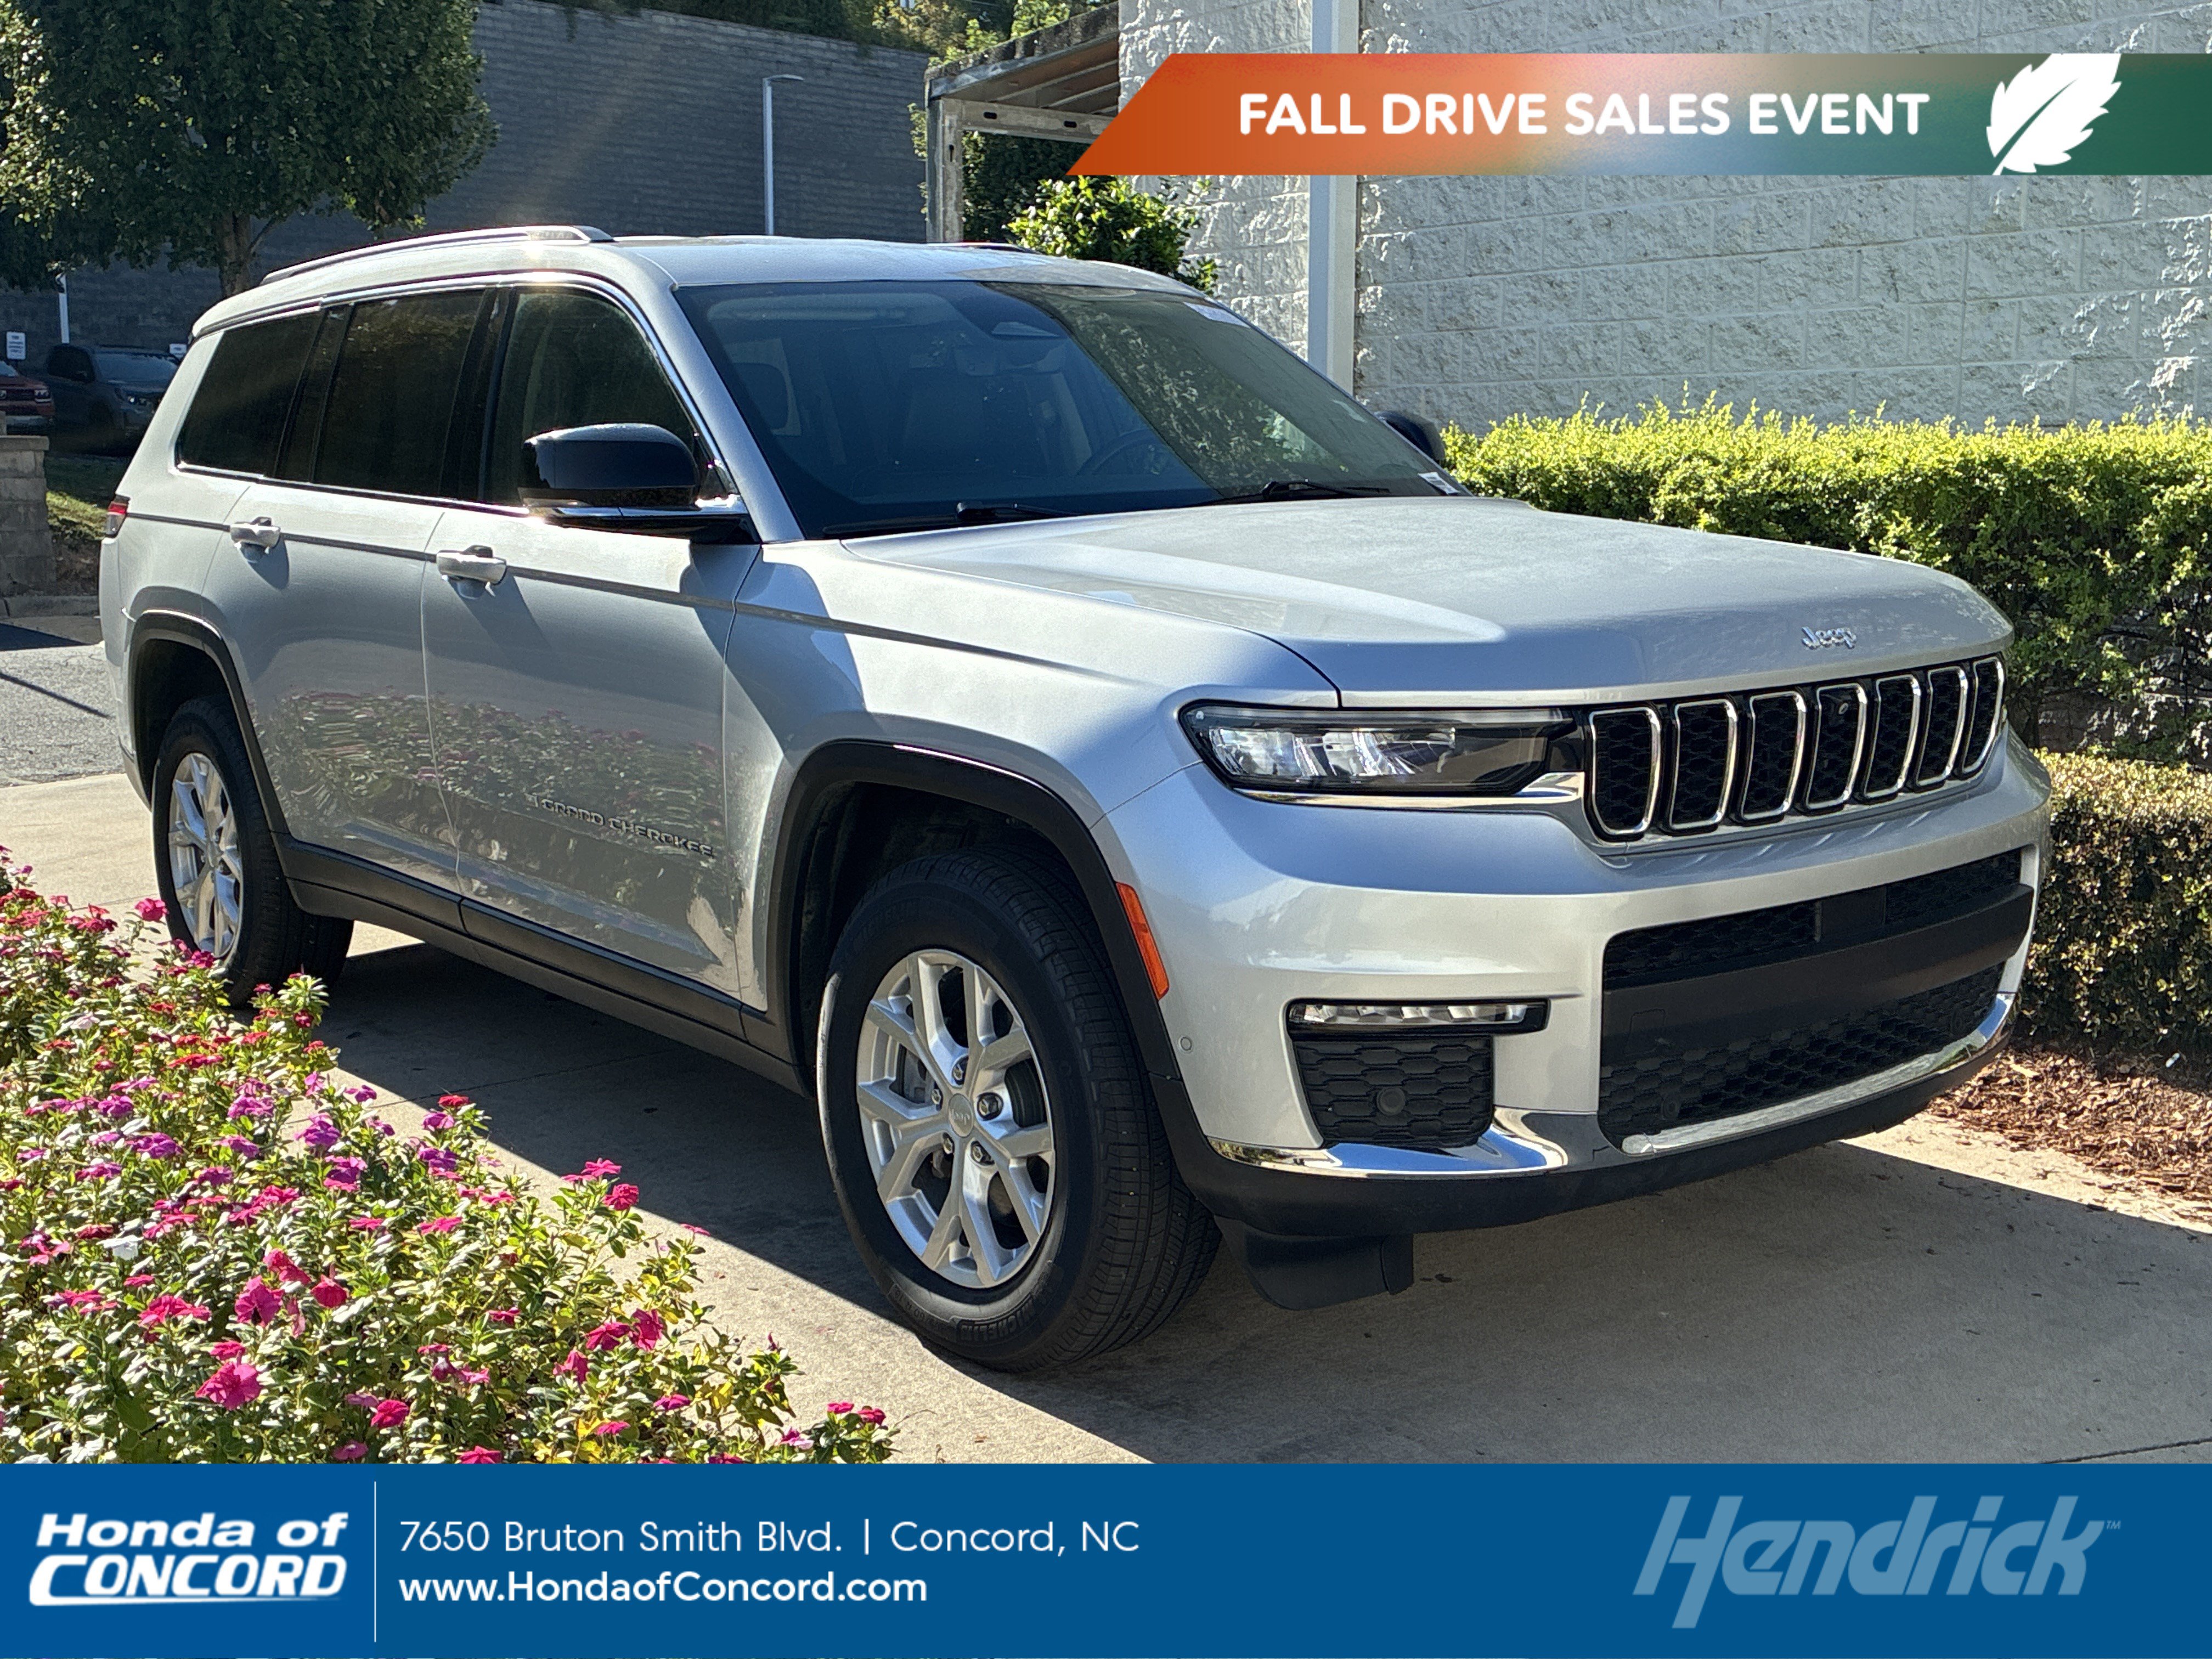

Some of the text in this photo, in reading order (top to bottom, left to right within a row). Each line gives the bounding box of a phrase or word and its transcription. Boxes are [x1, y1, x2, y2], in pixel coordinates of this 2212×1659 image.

[1801, 627, 1857, 650] Jeep
[541, 798, 715, 857] GRAND CHEROKEE
